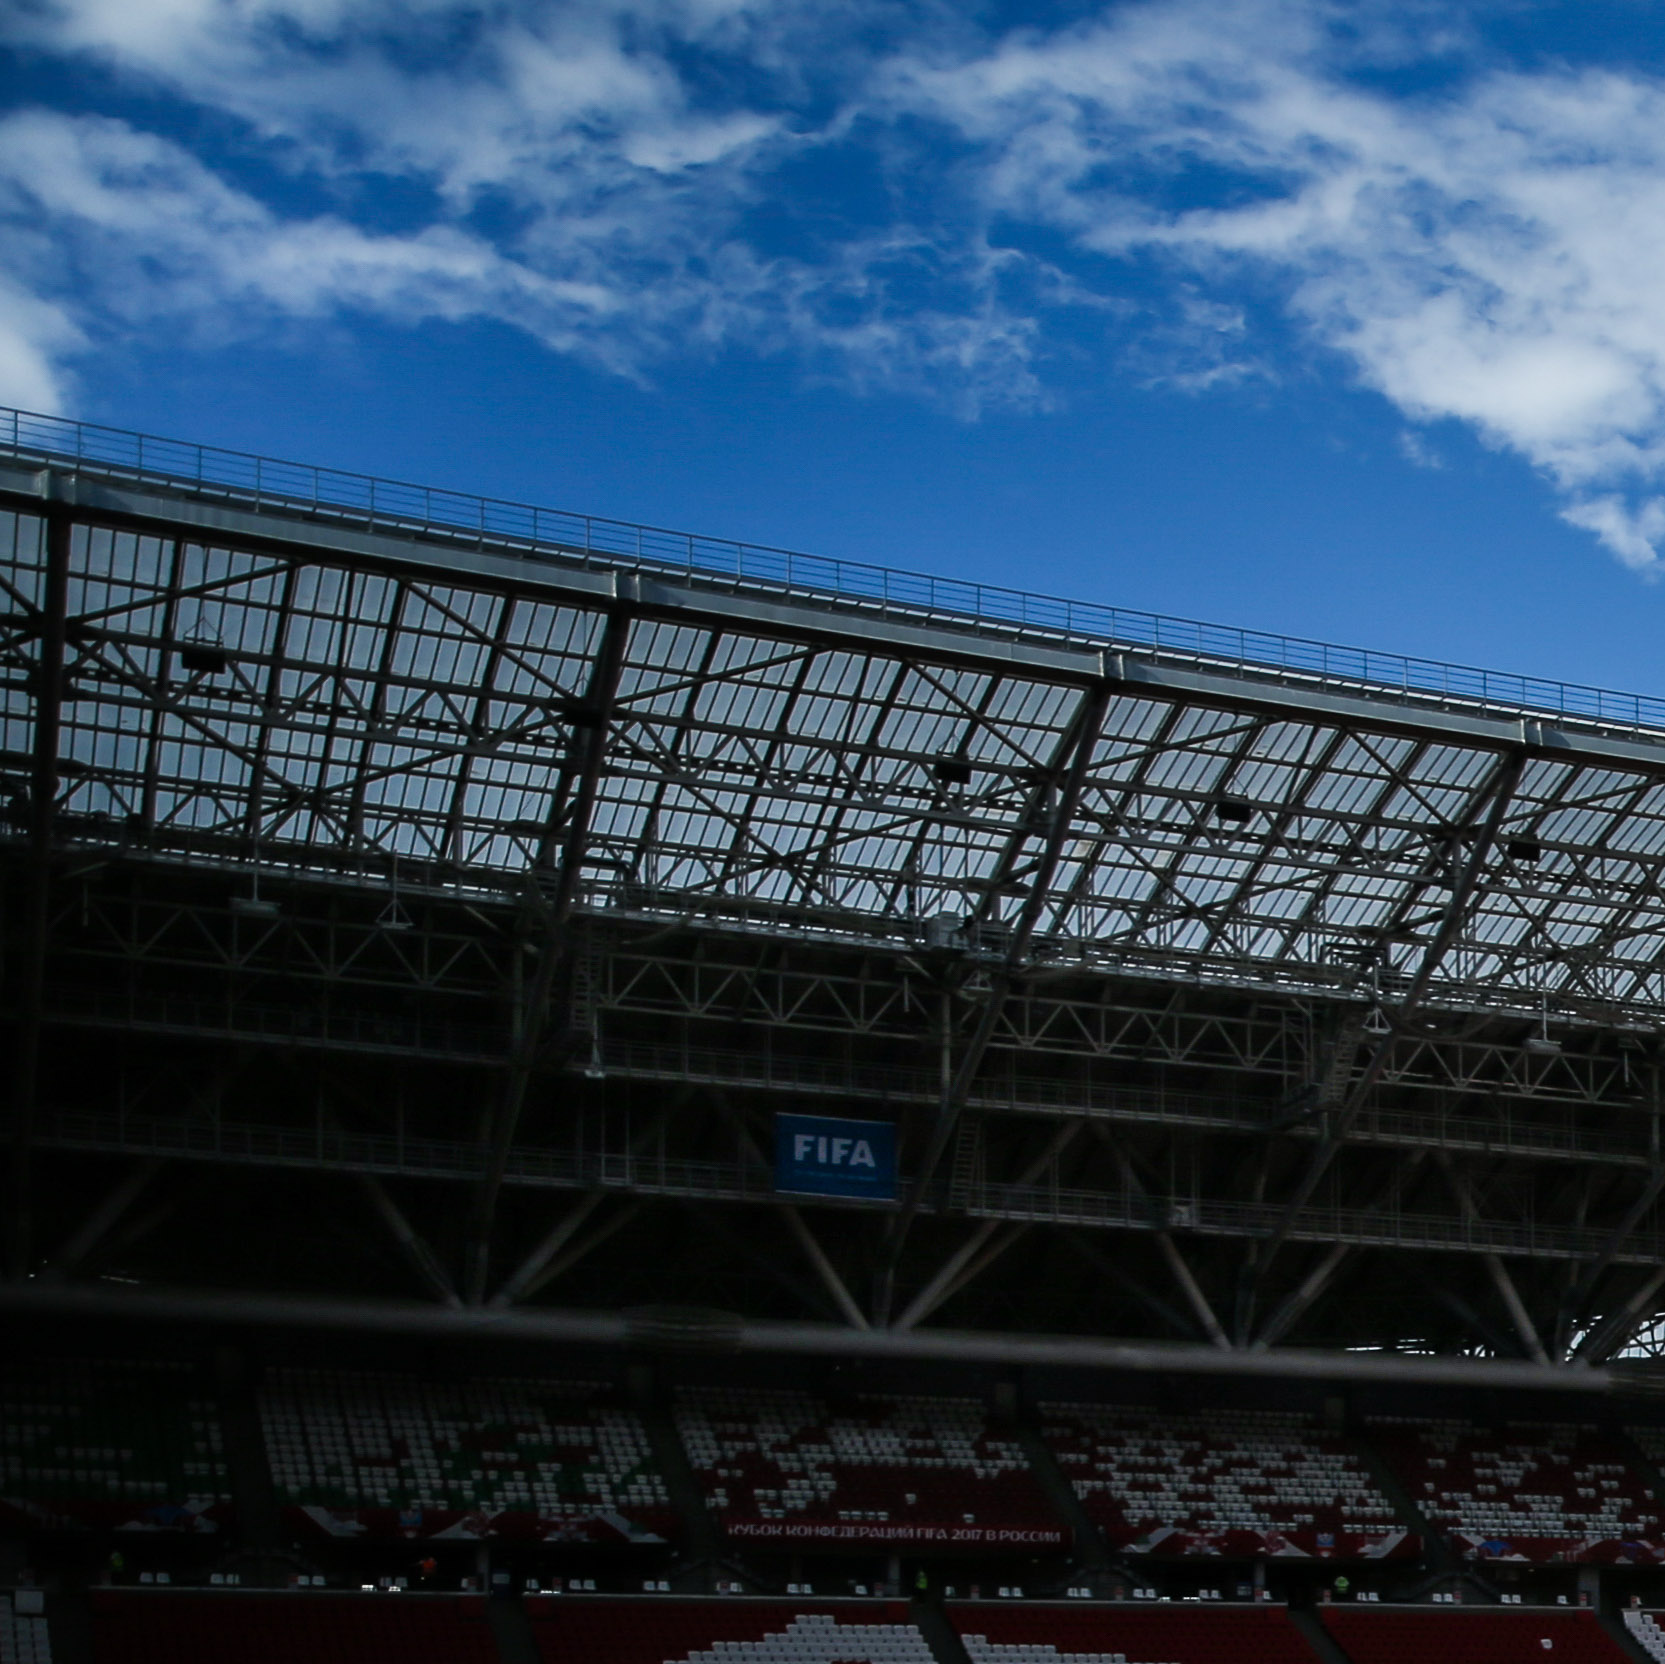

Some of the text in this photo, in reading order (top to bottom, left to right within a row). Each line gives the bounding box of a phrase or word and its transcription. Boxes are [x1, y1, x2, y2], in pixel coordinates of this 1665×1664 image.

[794, 1134, 876, 1167] FIFA
[728, 1525, 782, 1536] КУБОК
[916, 1527, 948, 1540] FIFA
[951, 1529, 983, 1540] 2017
[1000, 1530, 1061, 1542] РОССИИ
